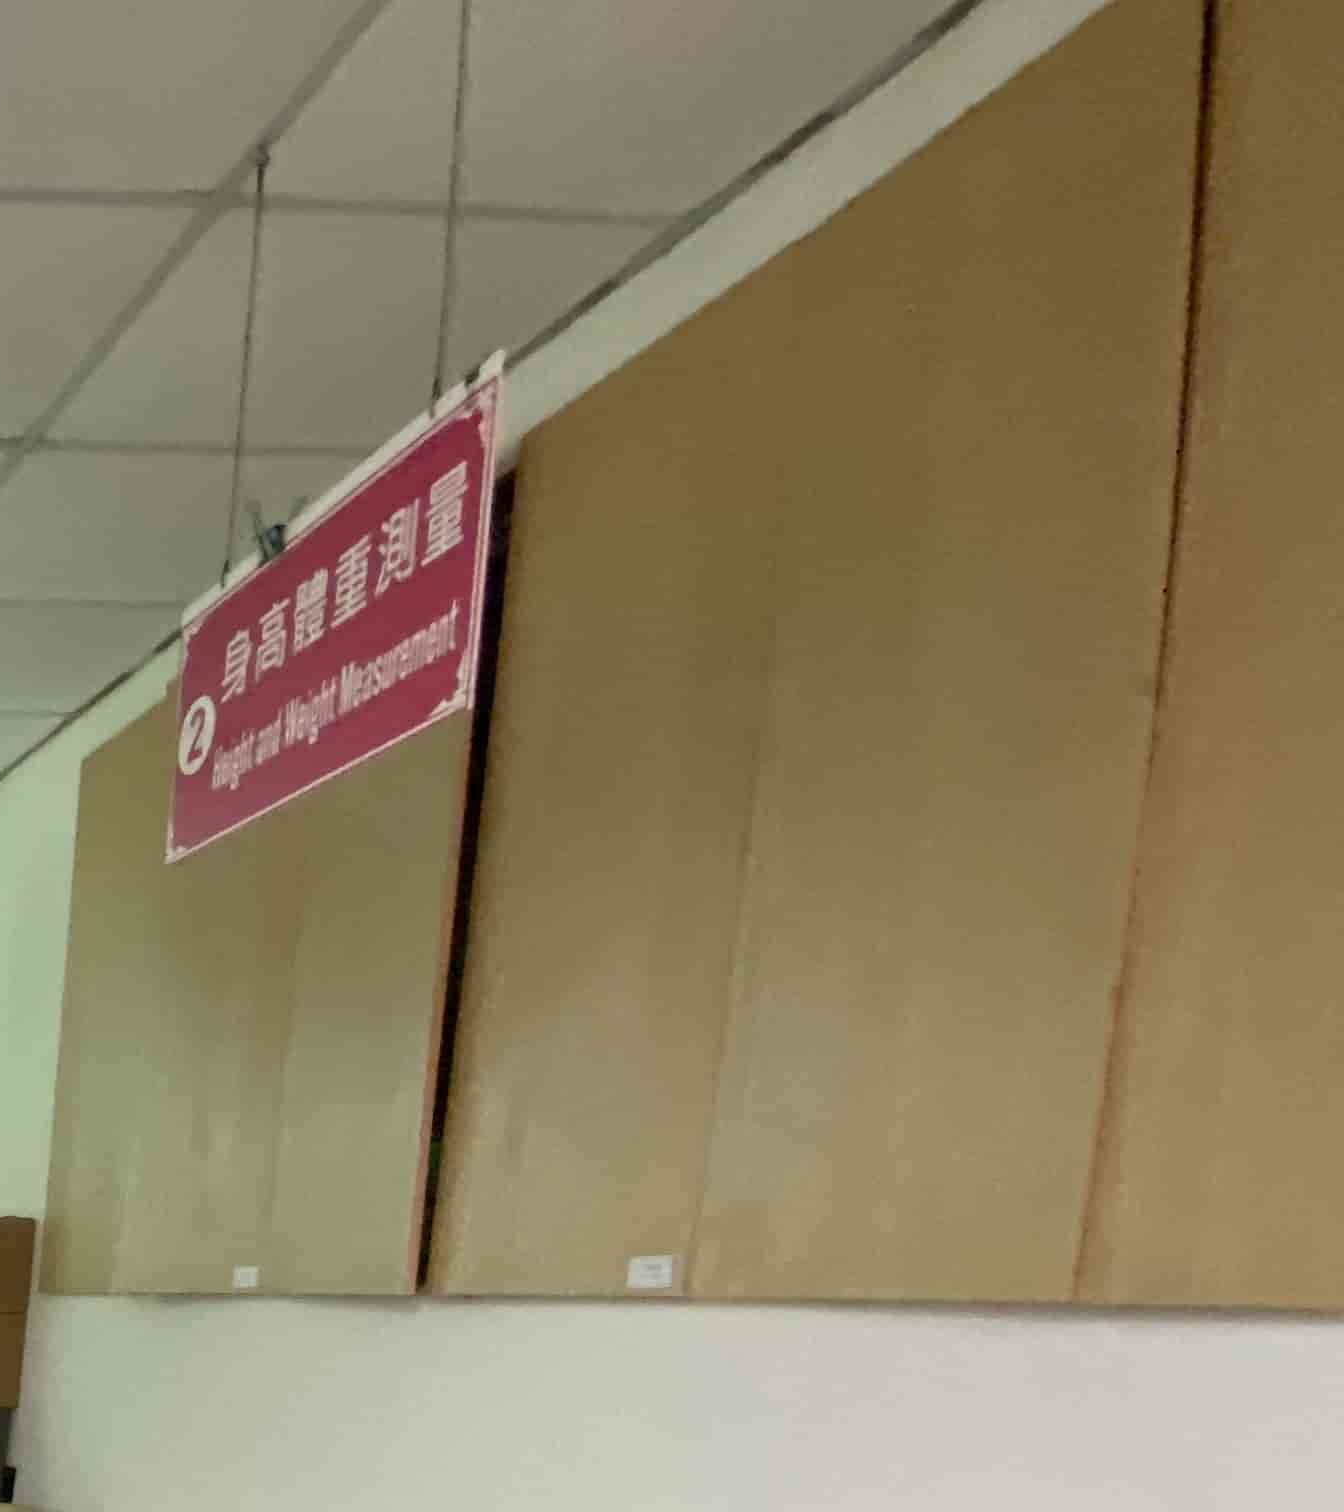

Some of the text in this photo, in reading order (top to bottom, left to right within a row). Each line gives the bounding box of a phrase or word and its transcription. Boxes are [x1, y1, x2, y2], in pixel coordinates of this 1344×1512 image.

[220, 461, 469, 703] 身高體重測量
[284, 676, 337, 747] Weight
[338, 598, 460, 717] Measurement
